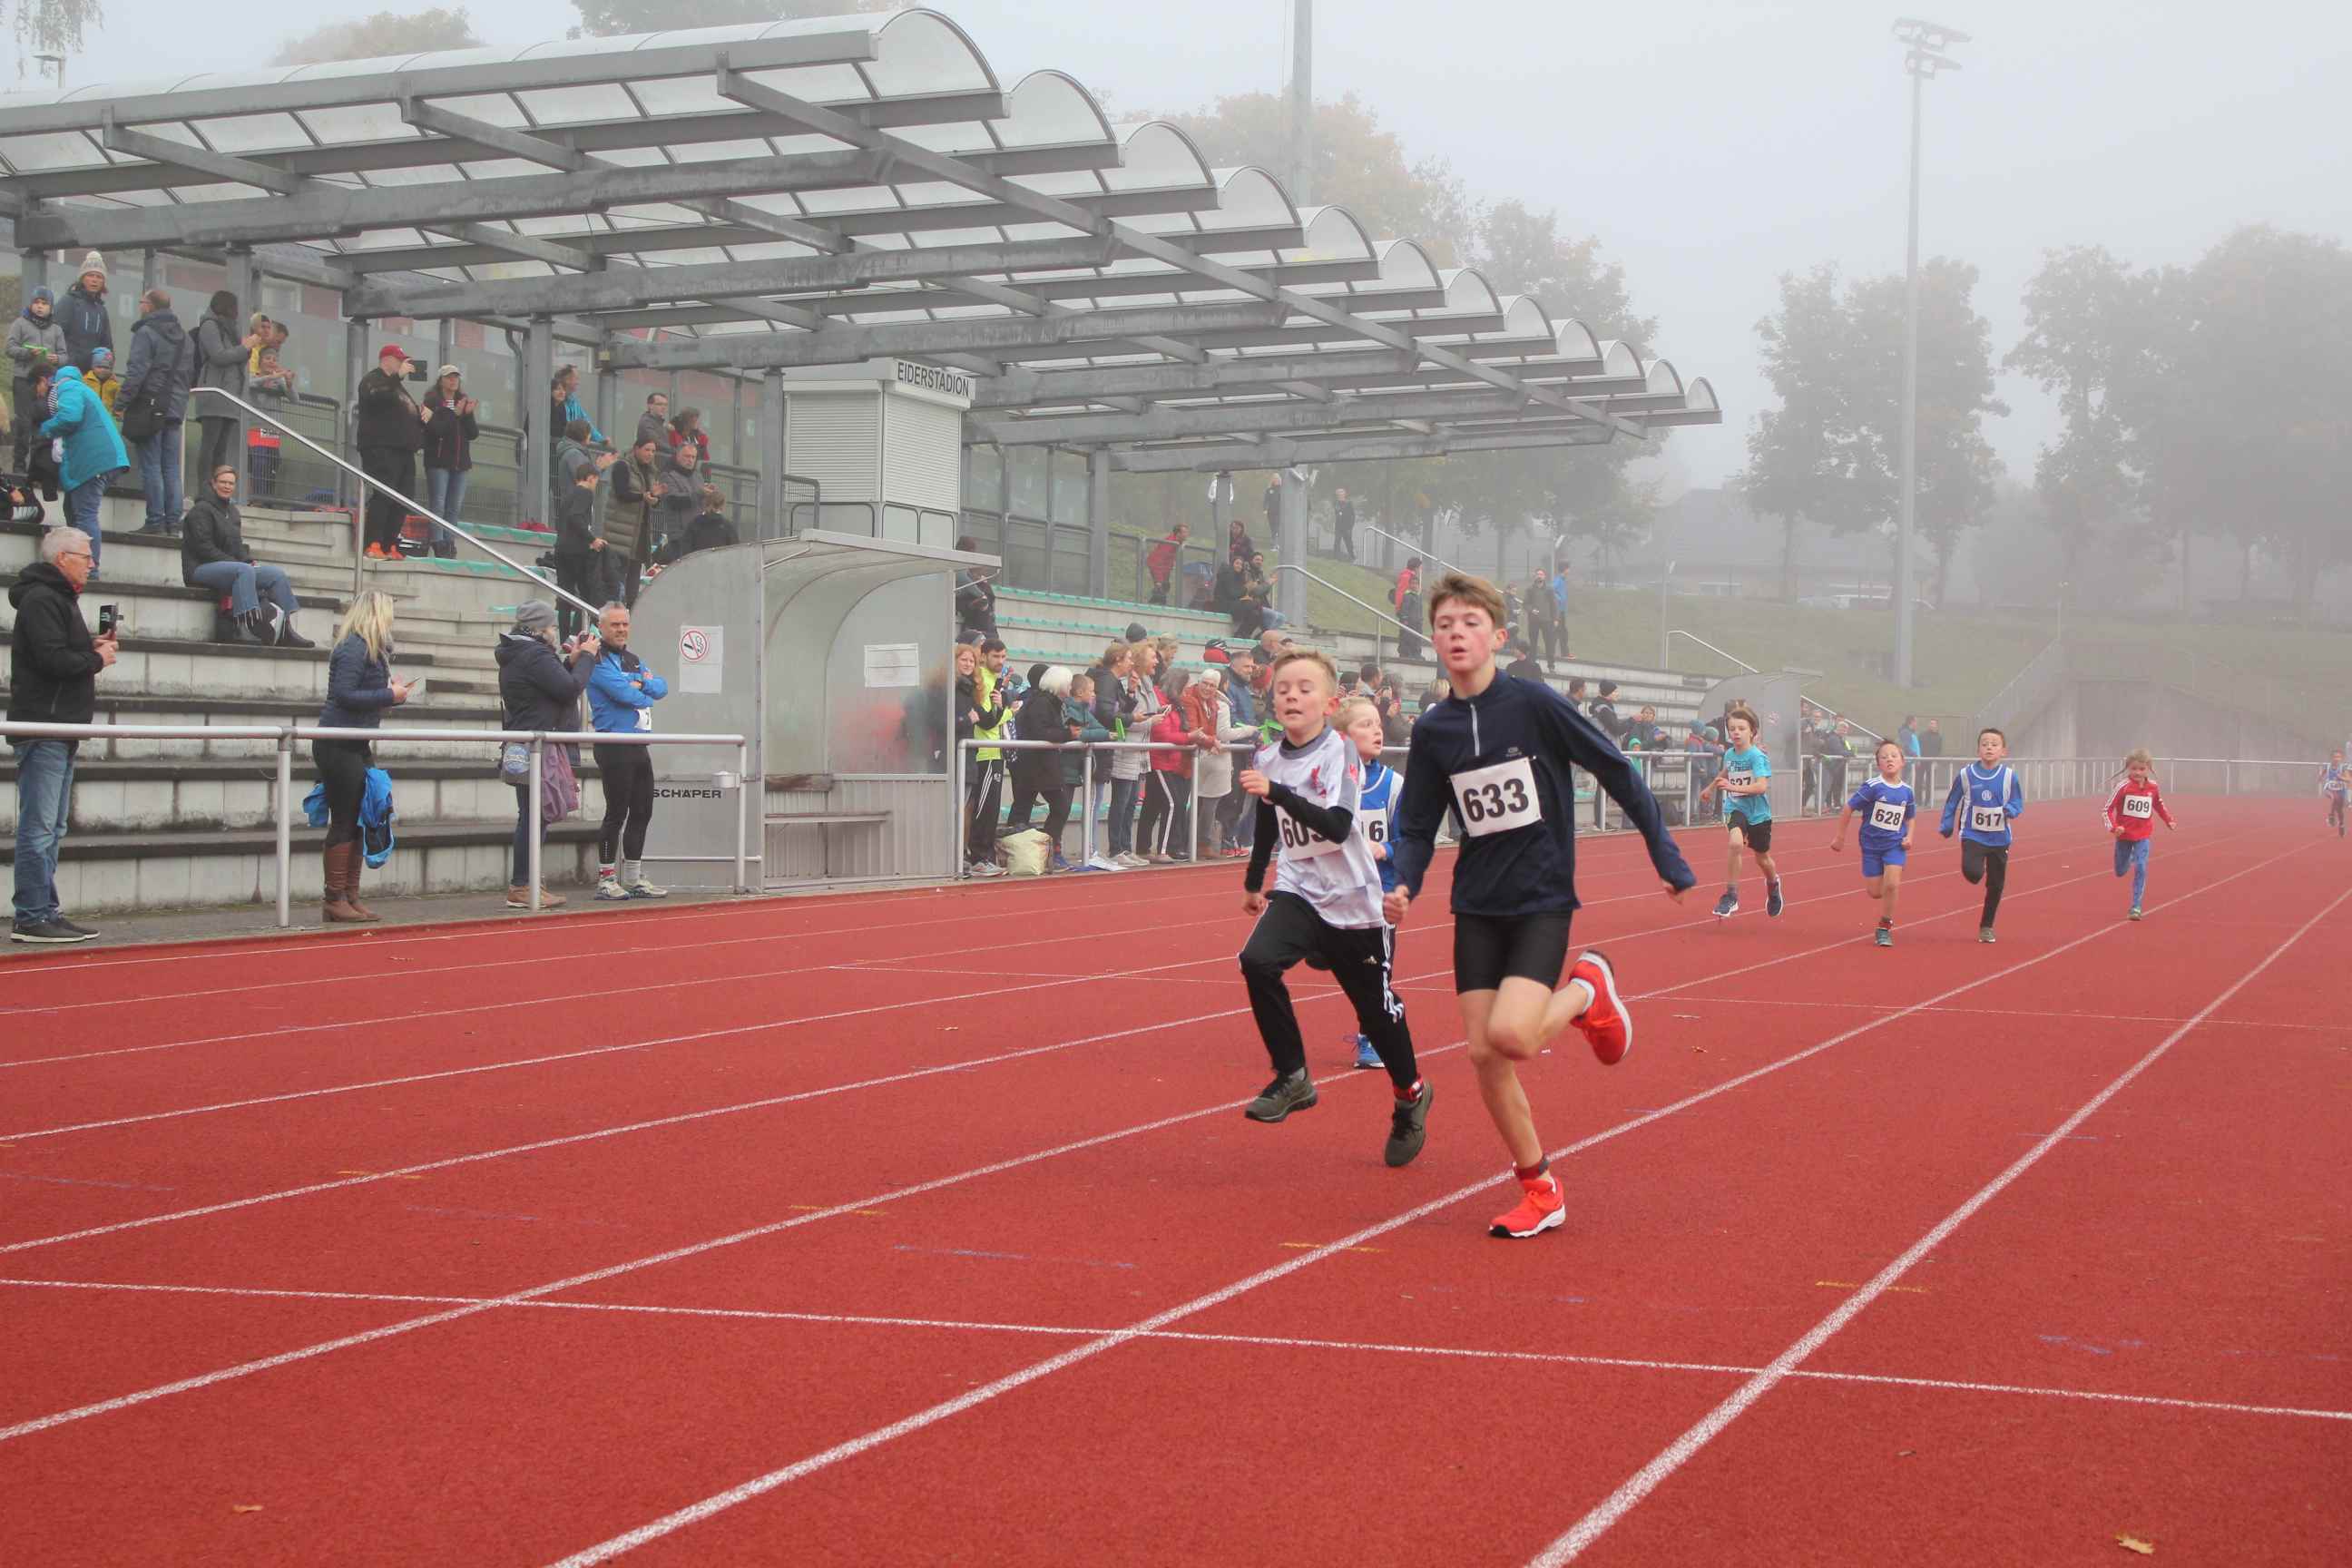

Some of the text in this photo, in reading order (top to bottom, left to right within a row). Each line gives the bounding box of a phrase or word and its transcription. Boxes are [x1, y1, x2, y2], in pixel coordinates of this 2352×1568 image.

[897, 362, 969, 397] EIDERSTADION
[1463, 778, 1529, 823] 633
[2127, 799, 2150, 813] 609
[1875, 808, 1902, 826] 628
[1975, 812, 2002, 827] 617
